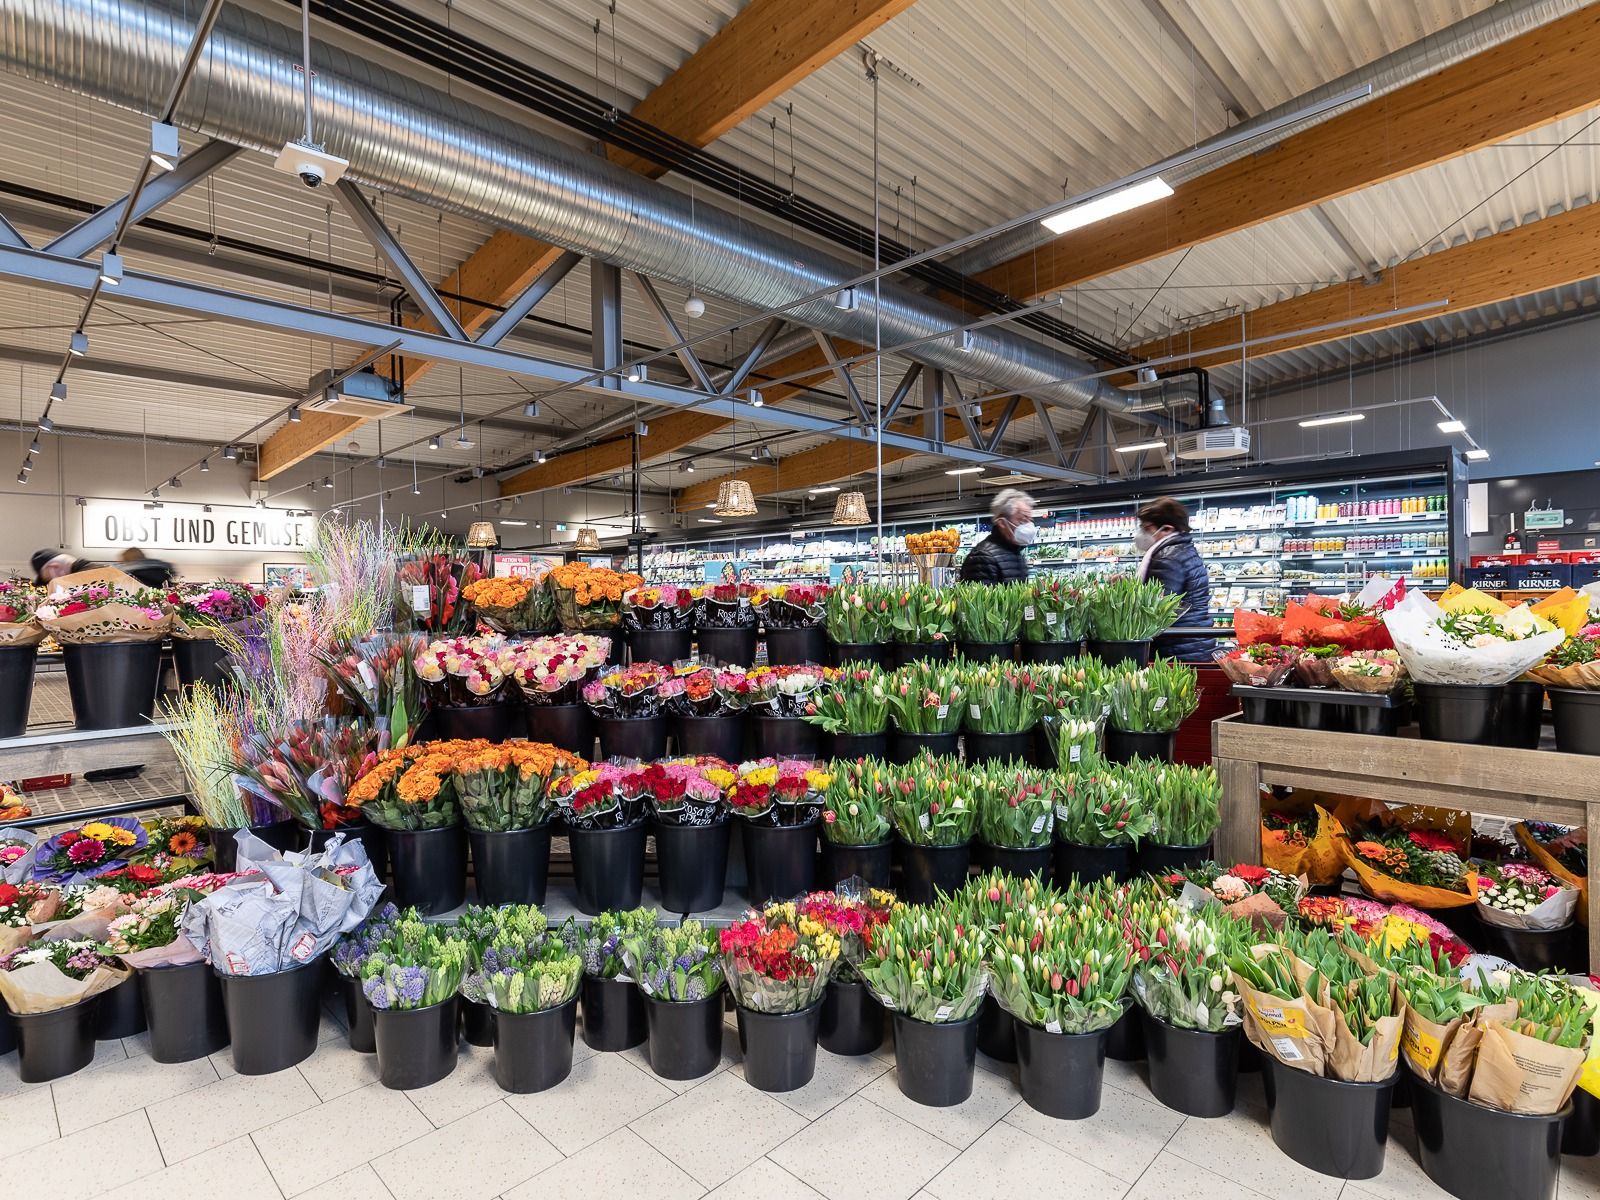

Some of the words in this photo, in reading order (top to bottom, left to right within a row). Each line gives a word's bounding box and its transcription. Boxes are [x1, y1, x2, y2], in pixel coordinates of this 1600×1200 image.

[105, 514, 161, 543] OBST
[173, 517, 216, 544] UND
[1472, 579, 1508, 588] KIRNER
[1518, 579, 1561, 588] KIRNER
